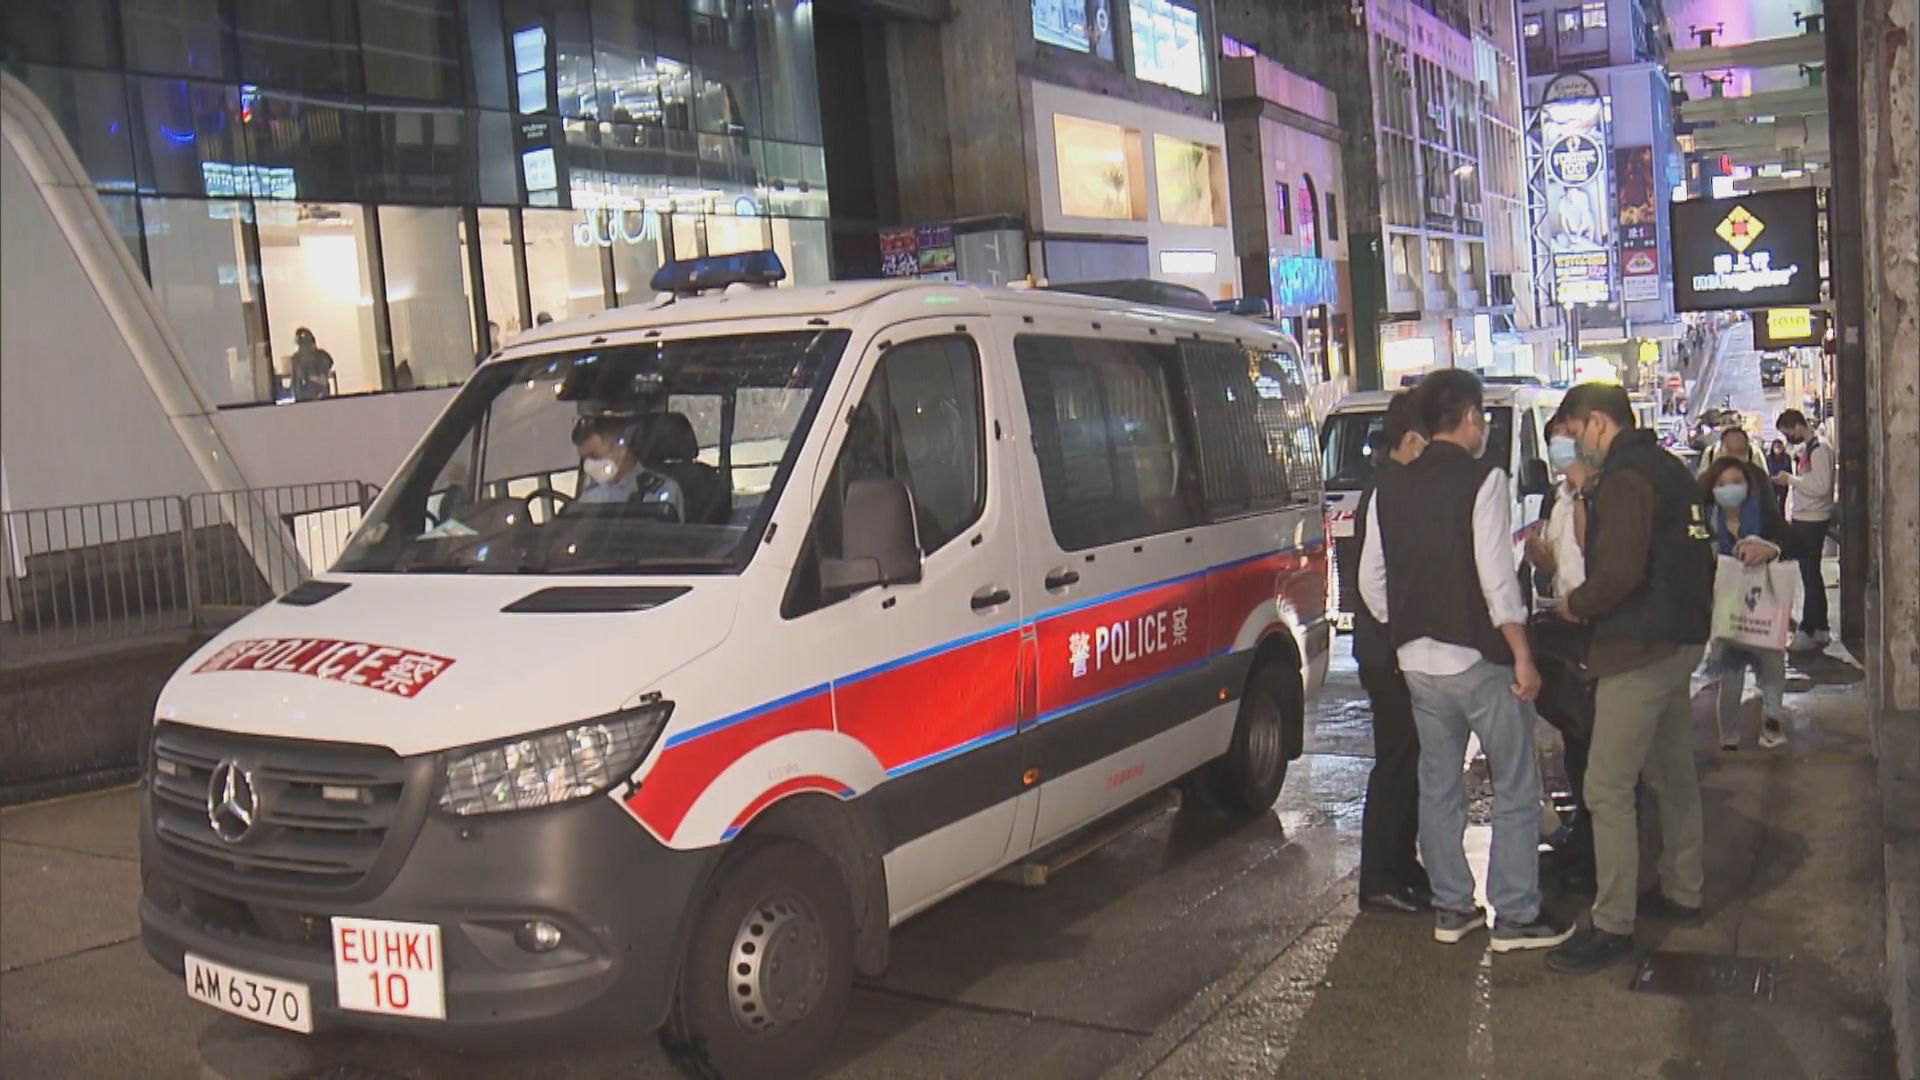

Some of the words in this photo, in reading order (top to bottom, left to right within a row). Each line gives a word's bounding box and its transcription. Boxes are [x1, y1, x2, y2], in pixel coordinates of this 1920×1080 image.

[226, 639, 402, 685] POLICE
[370, 653, 443, 695] 察
[1068, 631, 1091, 678] 警
[1095, 611, 1168, 671] POLICE
[1171, 606, 1188, 646] 察
[339, 927, 433, 971] EUHKI
[194, 963, 221, 1002] AM
[228, 976, 299, 1023] 6370
[369, 970, 409, 1009] 10
